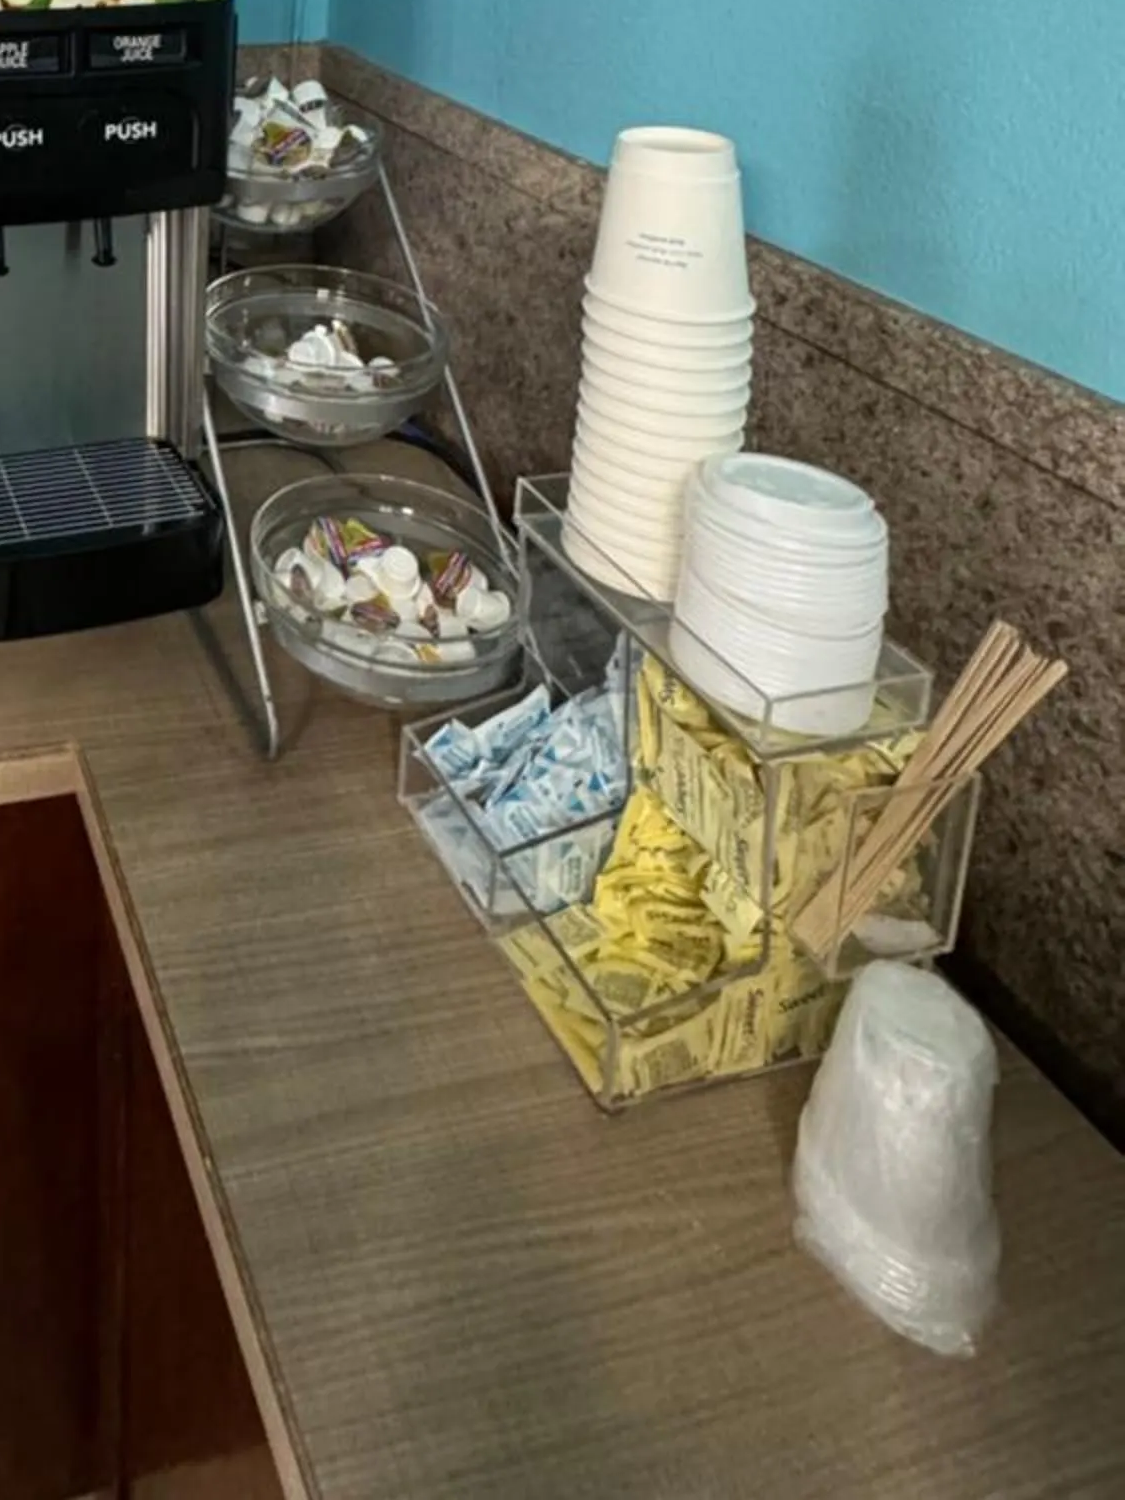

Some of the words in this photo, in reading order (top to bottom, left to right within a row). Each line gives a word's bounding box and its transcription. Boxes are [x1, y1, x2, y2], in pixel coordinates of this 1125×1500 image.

[113, 34, 162, 50] ORANGE
[120, 47, 154, 62] JUICE
[104, 120, 158, 141] PUSH
